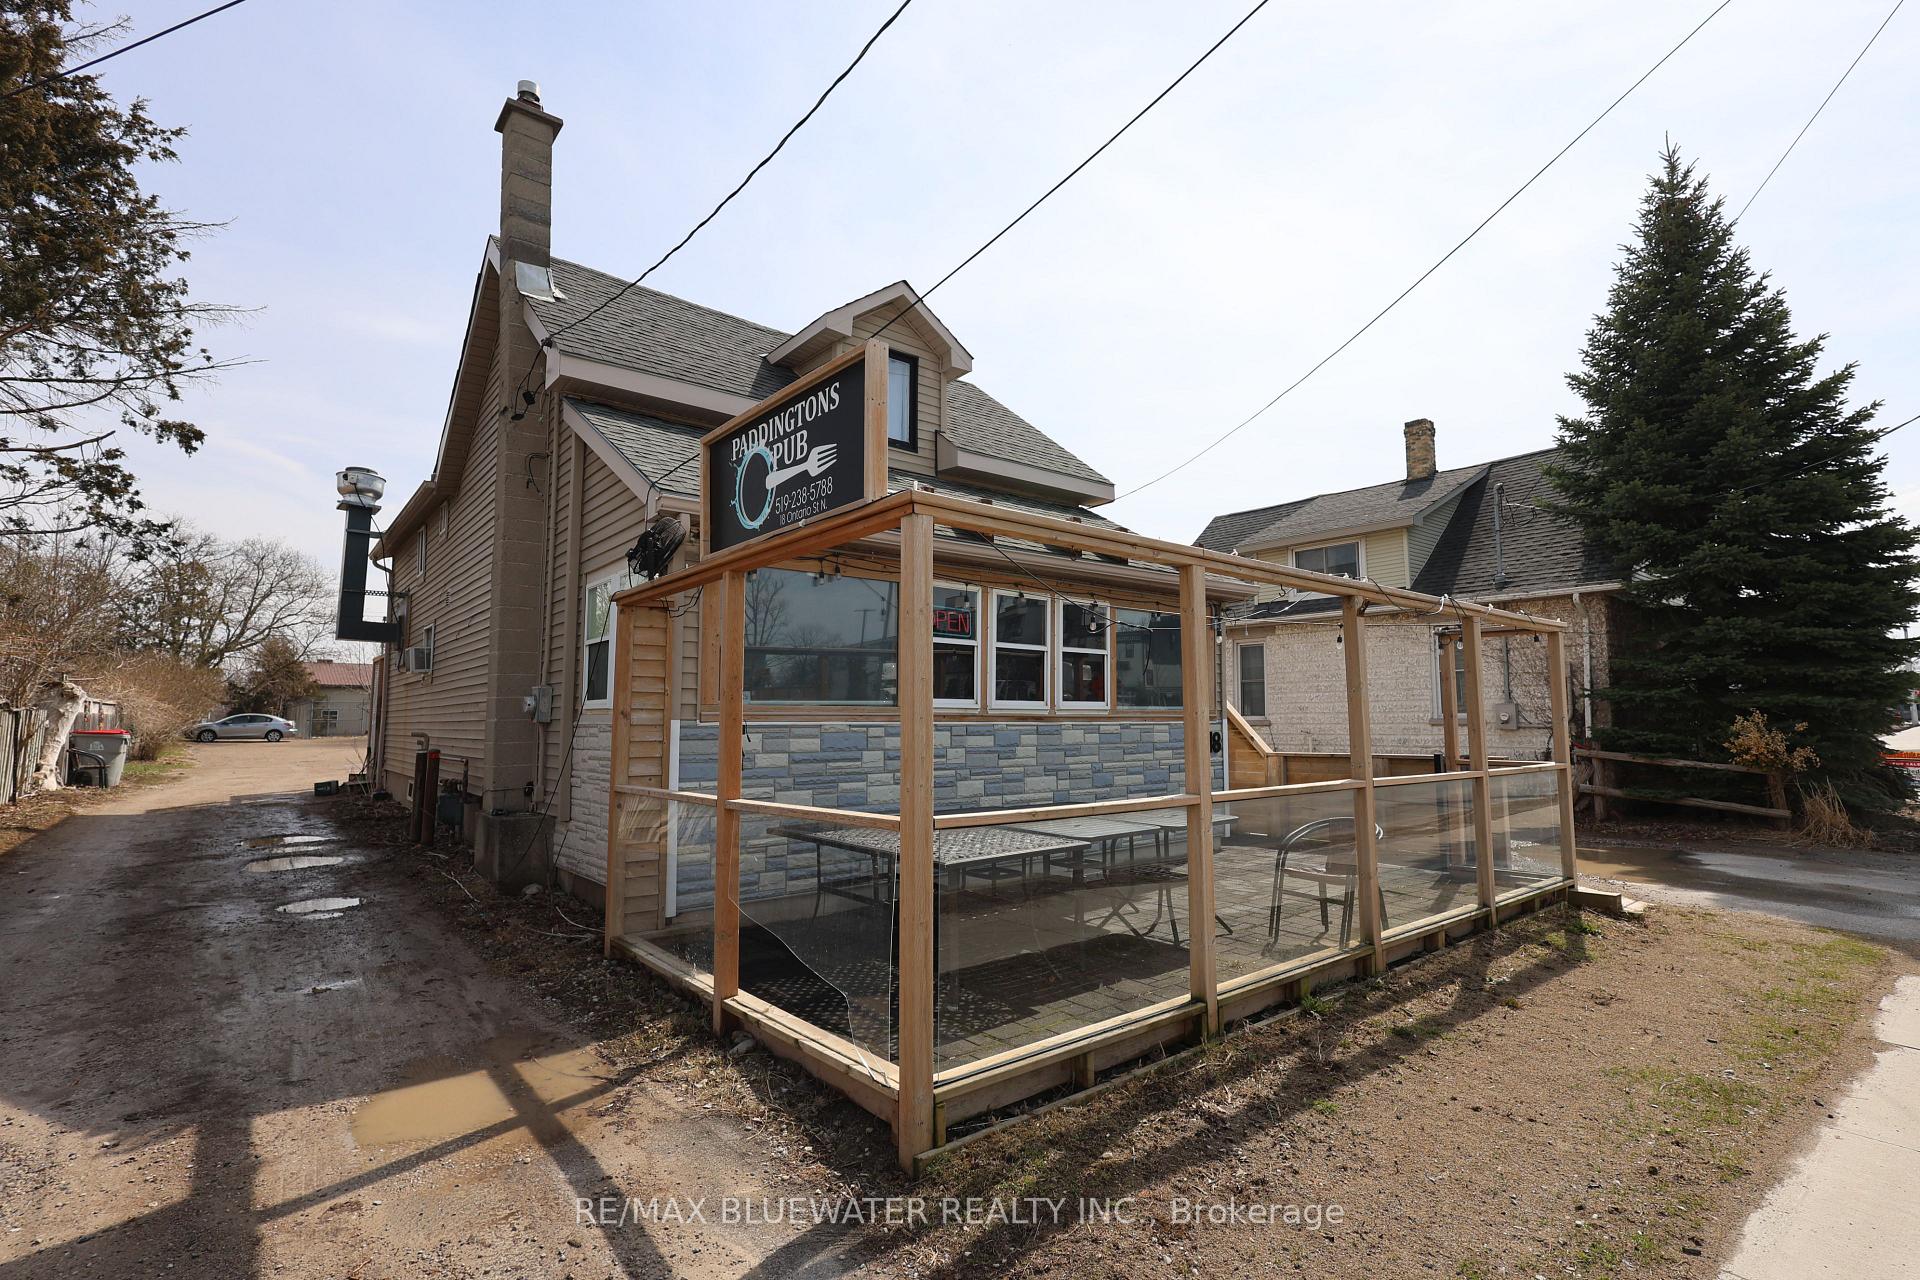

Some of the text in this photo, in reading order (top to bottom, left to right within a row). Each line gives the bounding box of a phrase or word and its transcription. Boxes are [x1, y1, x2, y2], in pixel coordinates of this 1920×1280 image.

[730, 381, 840, 461] PADDINGTONS
[772, 429, 808, 472] PUB
[775, 476, 833, 514] 519-238-5788
[780, 513, 786, 526] 18
[786, 505, 812, 523] Ontario
[812, 500, 819, 514] St
[933, 609, 970, 633] PEN
